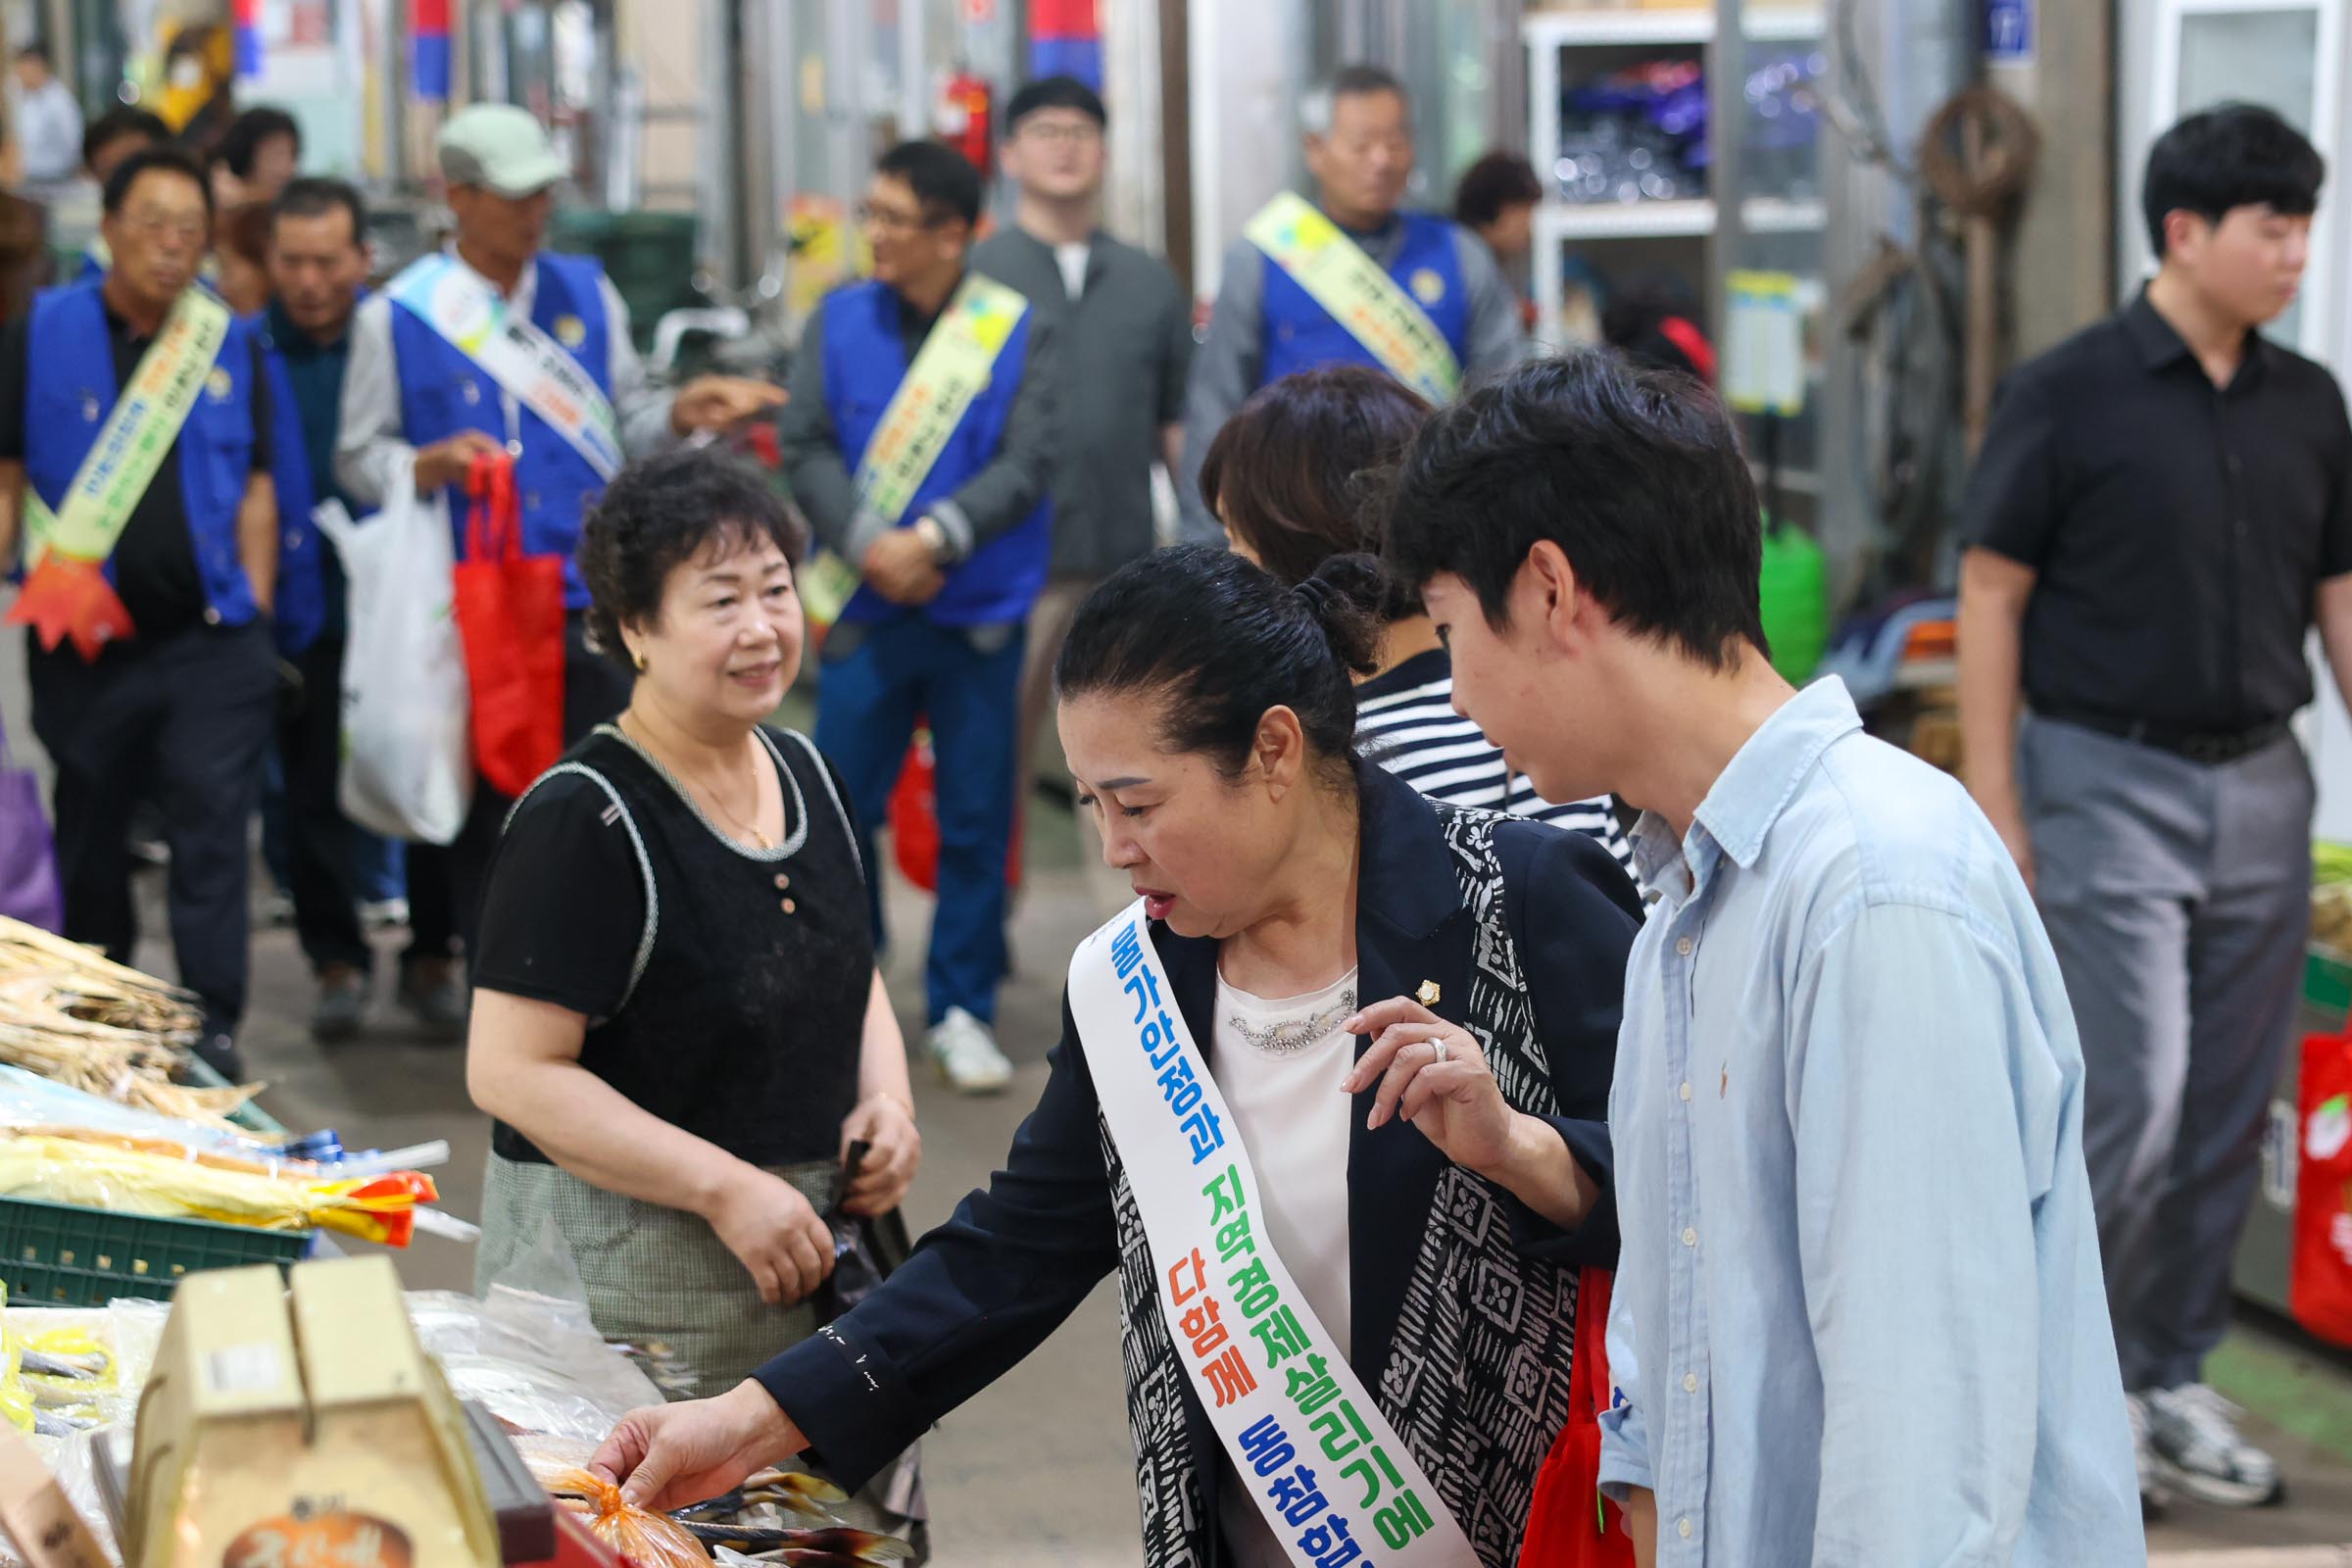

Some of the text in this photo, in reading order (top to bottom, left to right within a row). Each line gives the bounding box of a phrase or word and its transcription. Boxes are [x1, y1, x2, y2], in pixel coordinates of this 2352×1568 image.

[1111, 920, 1435, 1550] 물가안정과 지역경제살리기에
[1168, 1247, 1375, 1568] 다함께 동참합
